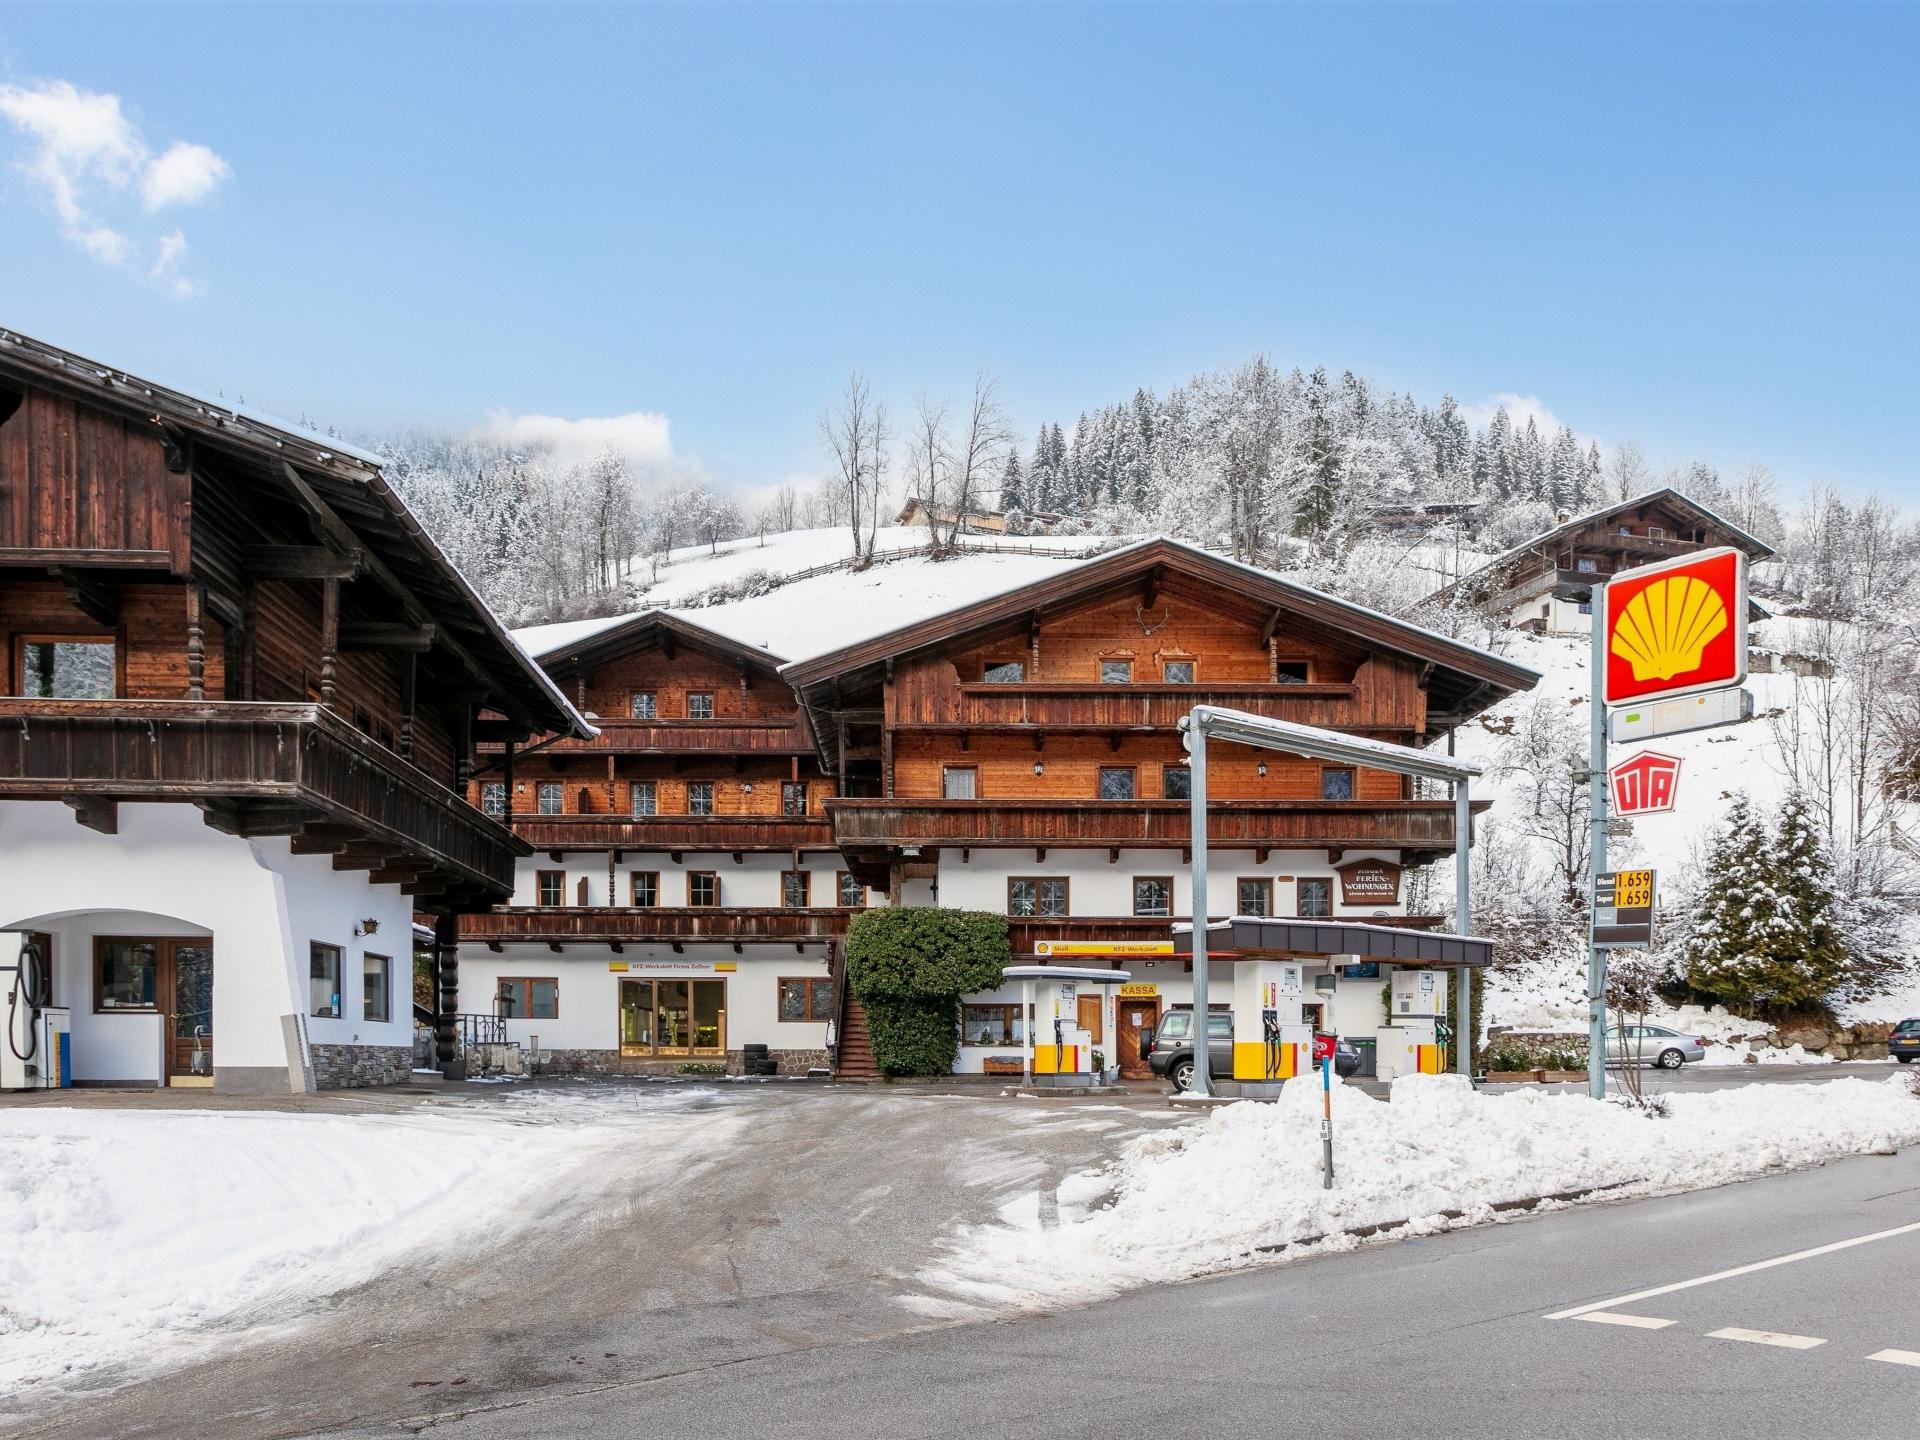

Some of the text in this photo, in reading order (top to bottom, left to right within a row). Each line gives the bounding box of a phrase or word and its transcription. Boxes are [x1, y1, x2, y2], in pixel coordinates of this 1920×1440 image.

[1615, 755, 1676, 811] UTA
[1596, 871, 1650, 888] Diesel 1.659
[1596, 890, 1649, 906] Super 1.659
[1121, 986, 1155, 995] KASSA
